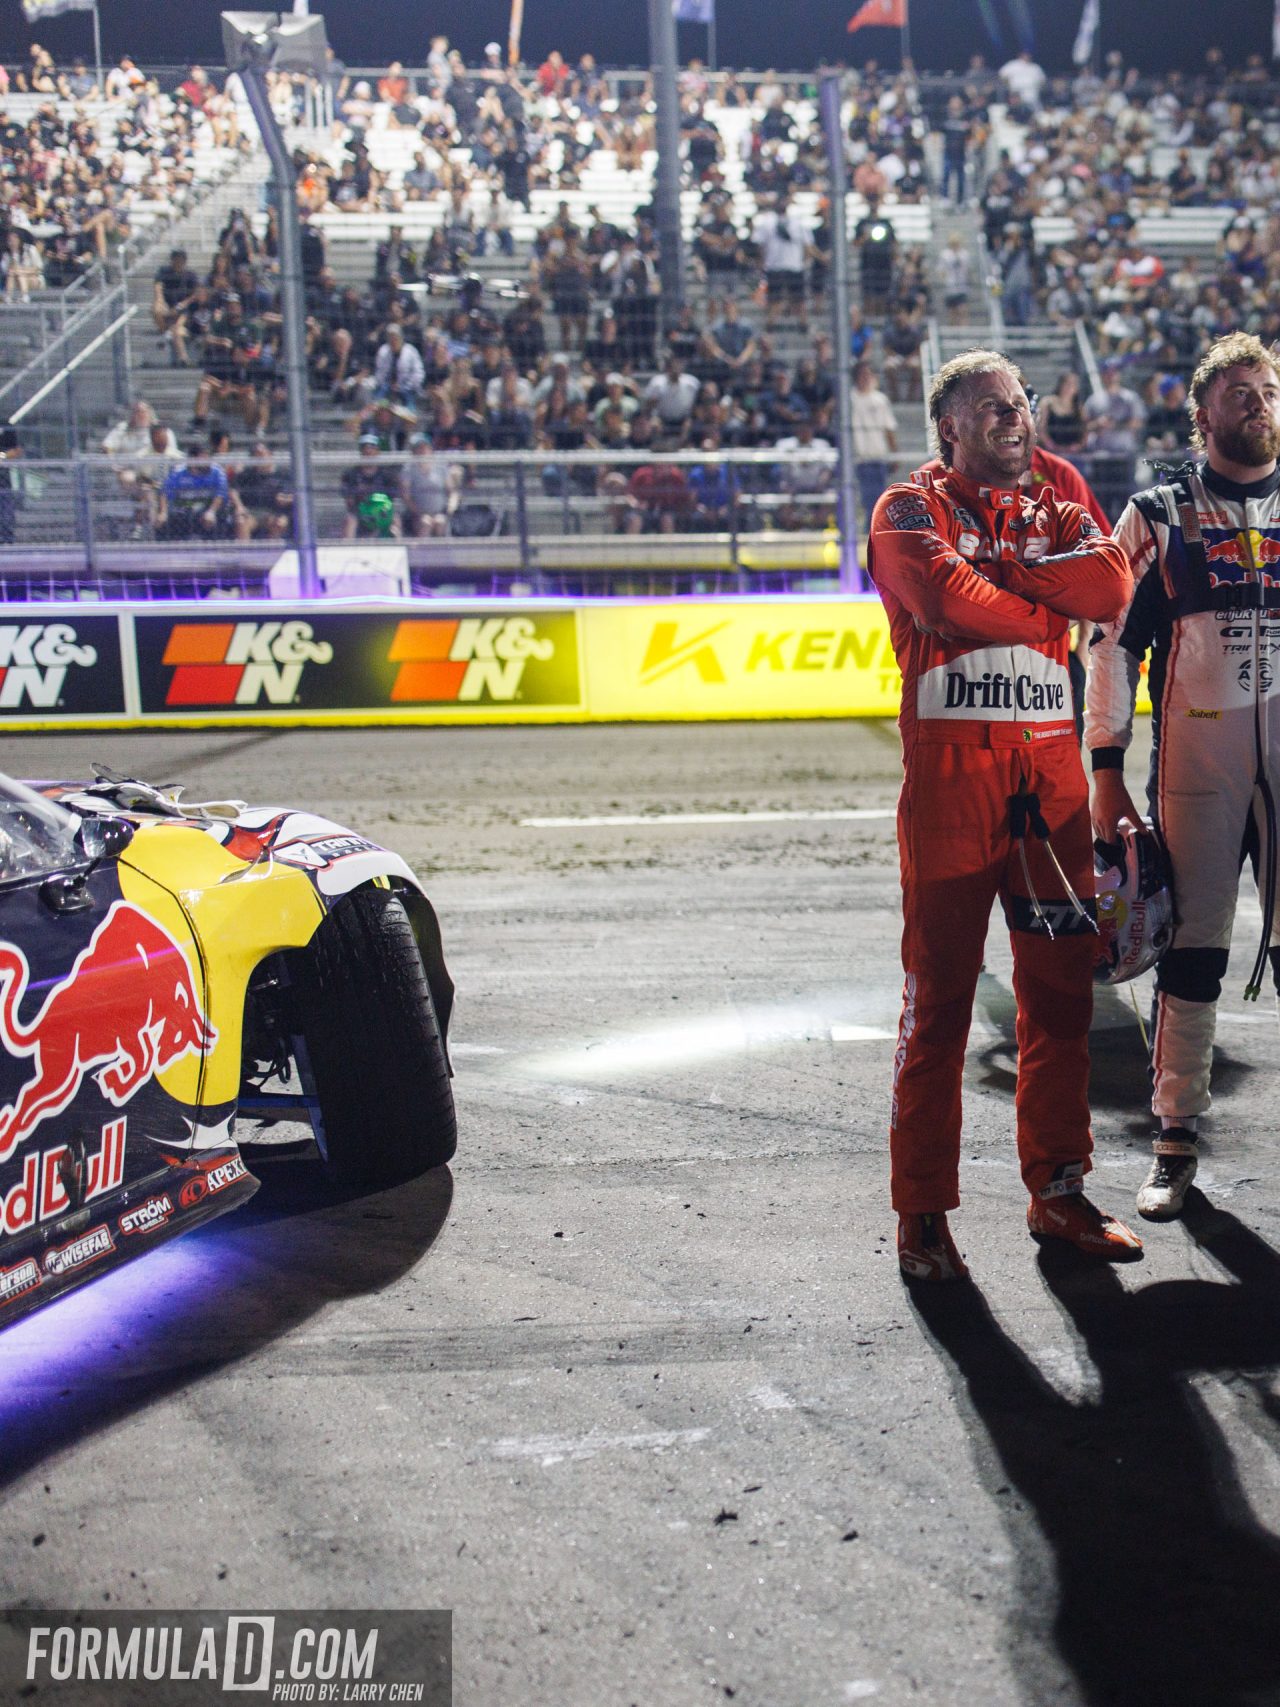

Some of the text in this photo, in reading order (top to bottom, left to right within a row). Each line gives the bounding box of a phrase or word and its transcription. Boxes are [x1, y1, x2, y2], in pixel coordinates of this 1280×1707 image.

[745, 629, 897, 671] KEN
[1188, 708, 1218, 720] Sabelt
[121, 1197, 171, 1232] STRÖM
[61, 1232, 111, 1269] WISEFAB
[0, 1264, 34, 1293] erson
